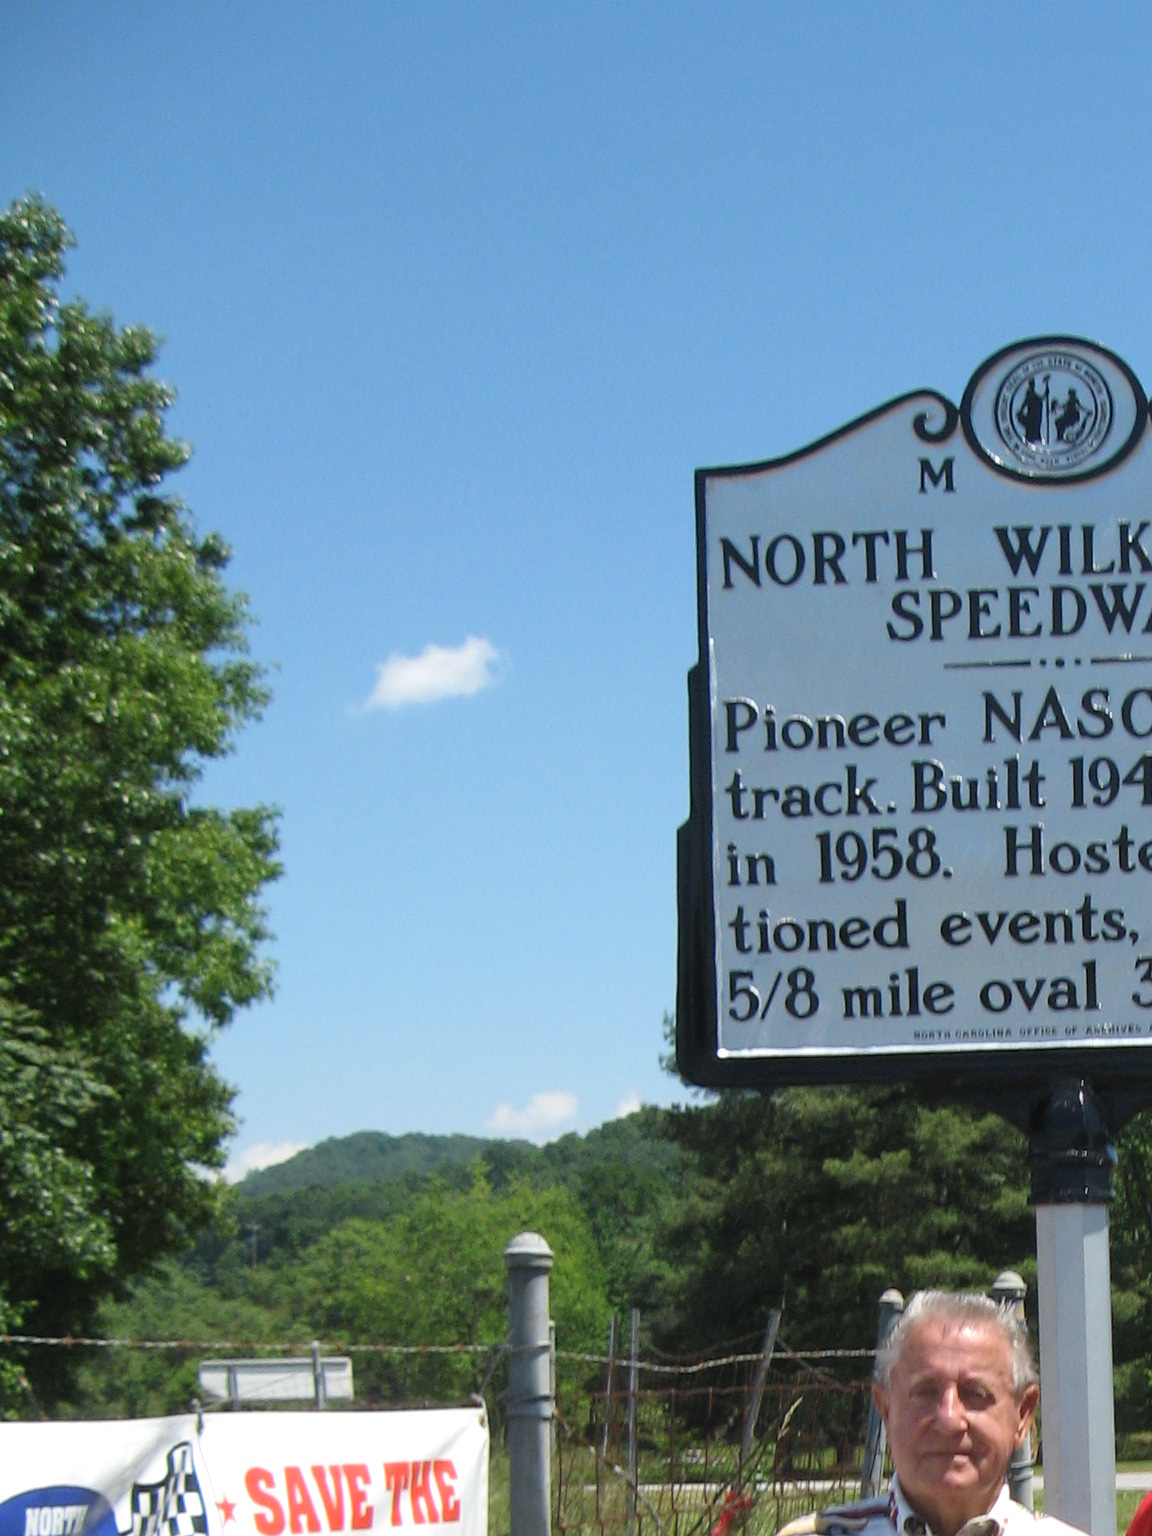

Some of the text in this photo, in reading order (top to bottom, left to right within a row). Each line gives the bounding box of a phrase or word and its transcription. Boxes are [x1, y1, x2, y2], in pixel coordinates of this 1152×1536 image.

[919, 458, 955, 493] M
[720, 530, 938, 588] NORTH
[725, 698, 946, 753] Pioneer
[727, 764, 897, 820] track.
[911, 756, 1046, 812] Built
[728, 842, 777, 886] in
[816, 827, 953, 884] 1958.
[728, 898, 908, 954] tioned
[940, 894, 1141, 946] events,
[728, 968, 819, 1021] 5/8
[843, 968, 955, 1018] mile
[980, 960, 1099, 1011] oval
[955, 1027, 1012, 1038] CAROLINA
[1019, 1026, 1057, 1036] OFFICE
[1064, 1026, 1078, 1035] OF
[244, 1459, 461, 1536] SAVE THE
